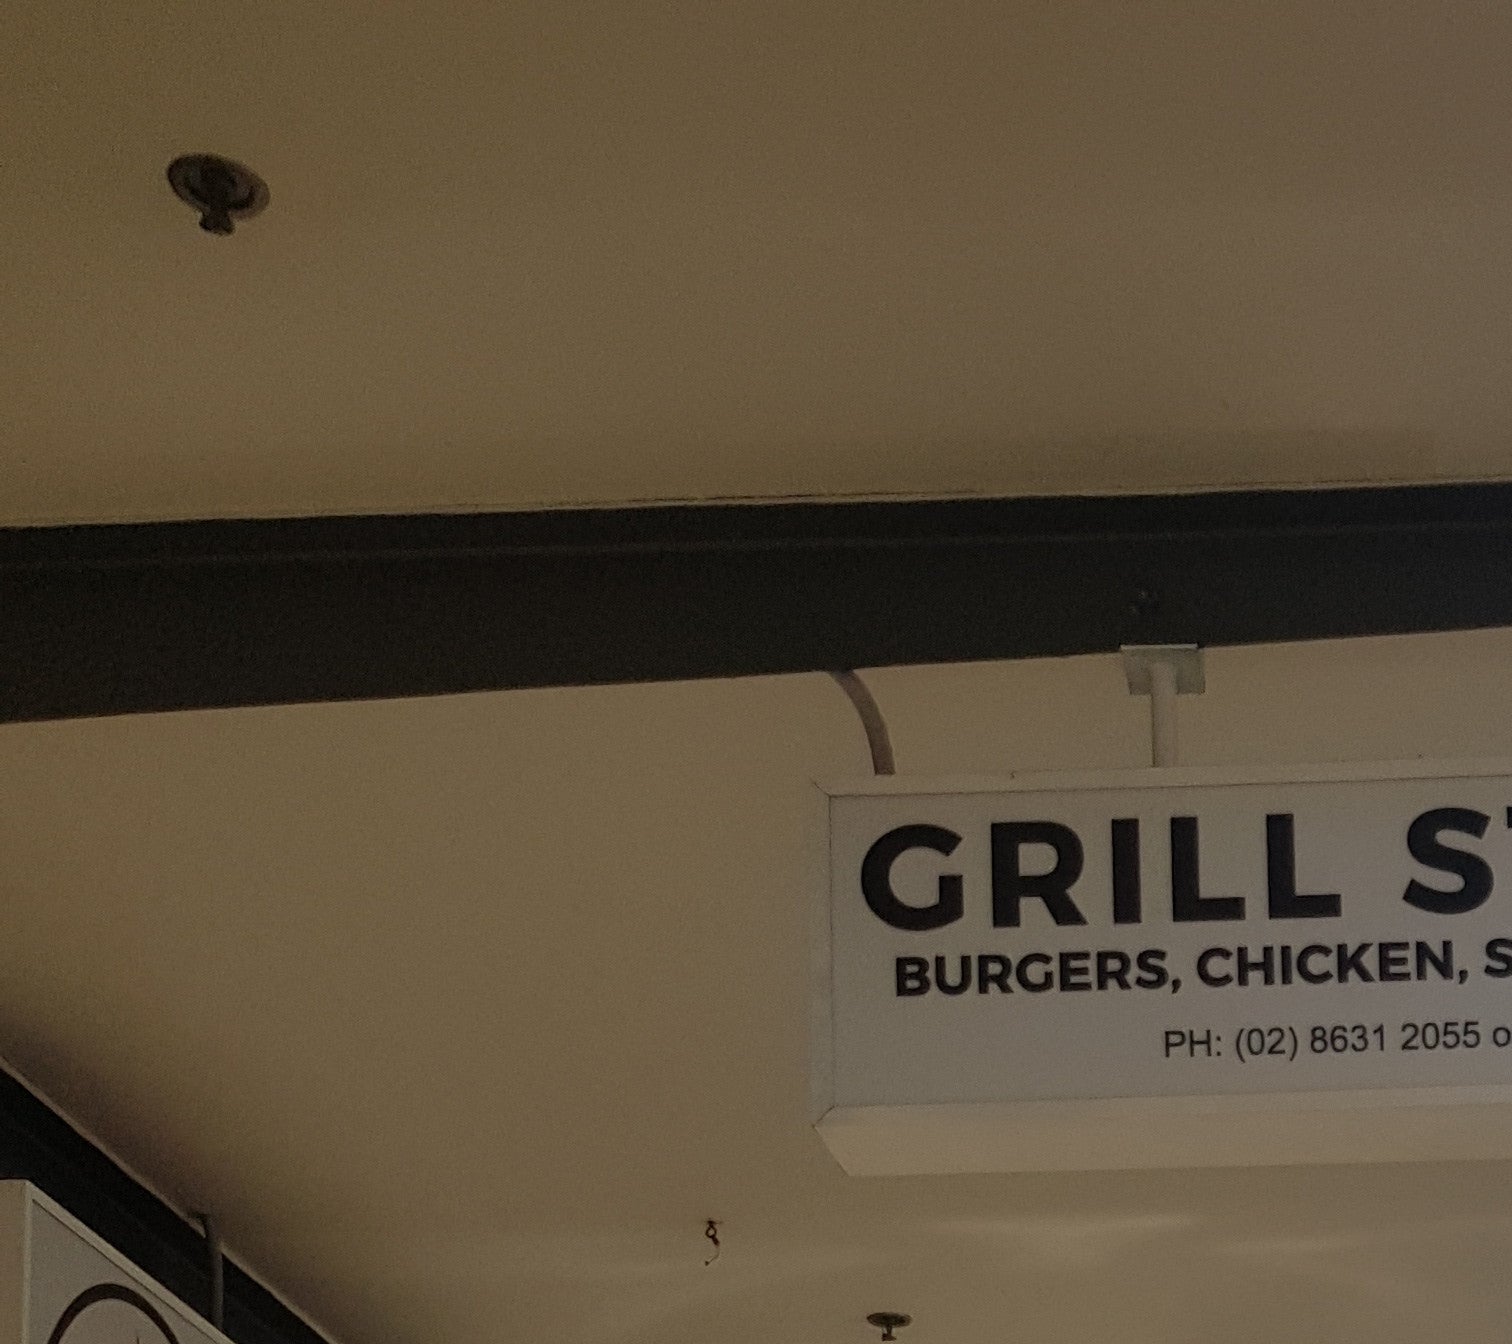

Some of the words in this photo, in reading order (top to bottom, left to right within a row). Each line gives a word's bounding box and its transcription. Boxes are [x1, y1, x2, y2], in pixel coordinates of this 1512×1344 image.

[860, 812, 1342, 931] GRILL
[895, 948, 1182, 997] BURGERS,
[1196, 938, 1469, 987] CHICKEN,
[1163, 1028, 1223, 1058] PH:
[1234, 1025, 1299, 1062] (02)
[1309, 1024, 1387, 1056] 8631
[1400, 1020, 1481, 1052] 2055
